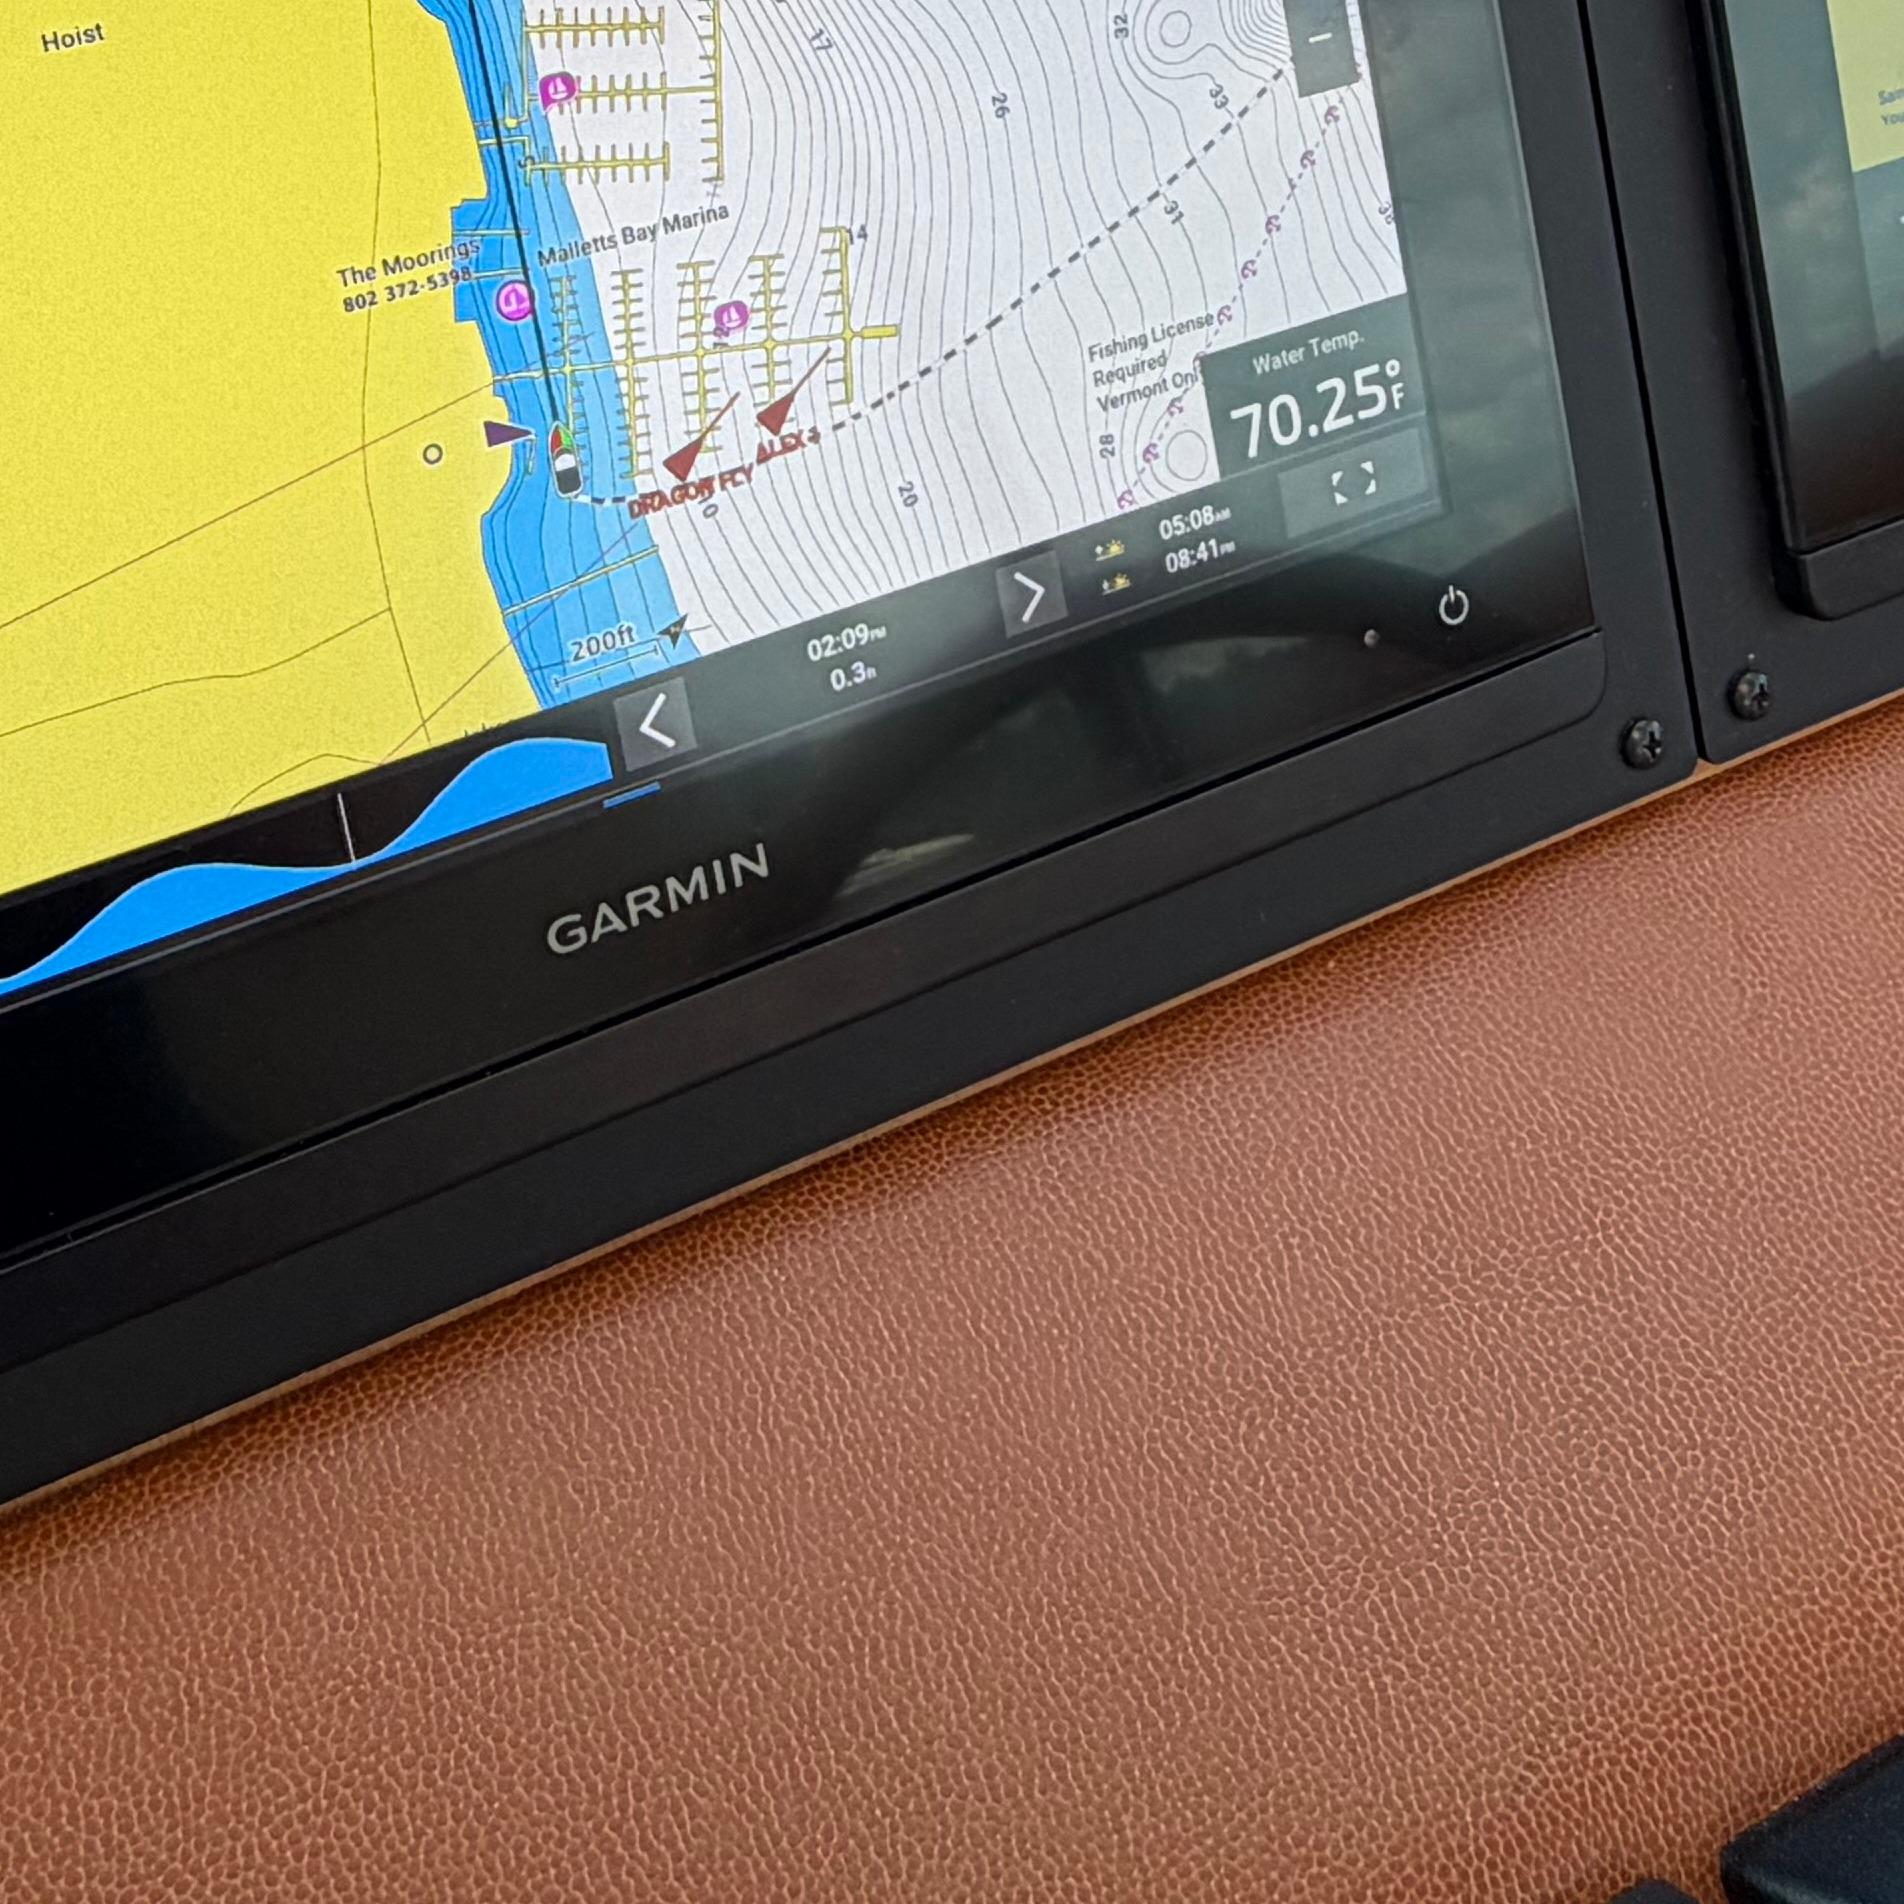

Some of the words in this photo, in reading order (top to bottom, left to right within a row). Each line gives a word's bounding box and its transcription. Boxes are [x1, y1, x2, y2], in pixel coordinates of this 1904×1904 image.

[41, 22, 105, 52] Hoist
[809, 27, 835, 52] 17
[1114, 14, 1129, 40] 32
[991, 92, 1009, 118] 26
[1164, 200, 1185, 225] 31
[536, 230, 617, 269] Malletts
[621, 220, 660, 252] Bay
[661, 201, 730, 237] Marina
[336, 265, 376, 288] The
[381, 239, 480, 278] Moorings
[342, 289, 378, 313] 802
[385, 266, 473, 303] 372-5398
[1088, 333, 1148, 363] Fishing
[1151, 312, 1214, 344] License
[1252, 344, 1305, 378] Water
[1307, 327, 1366, 367] Temp.
[1092, 348, 1169, 388] Required
[1096, 378, 1170, 412] Vermont
[1099, 433, 1115, 459] 28
[896, 480, 919, 507] 20
[572, 624, 635, 662] 200ft
[546, 841, 771, 956] GARMIN
